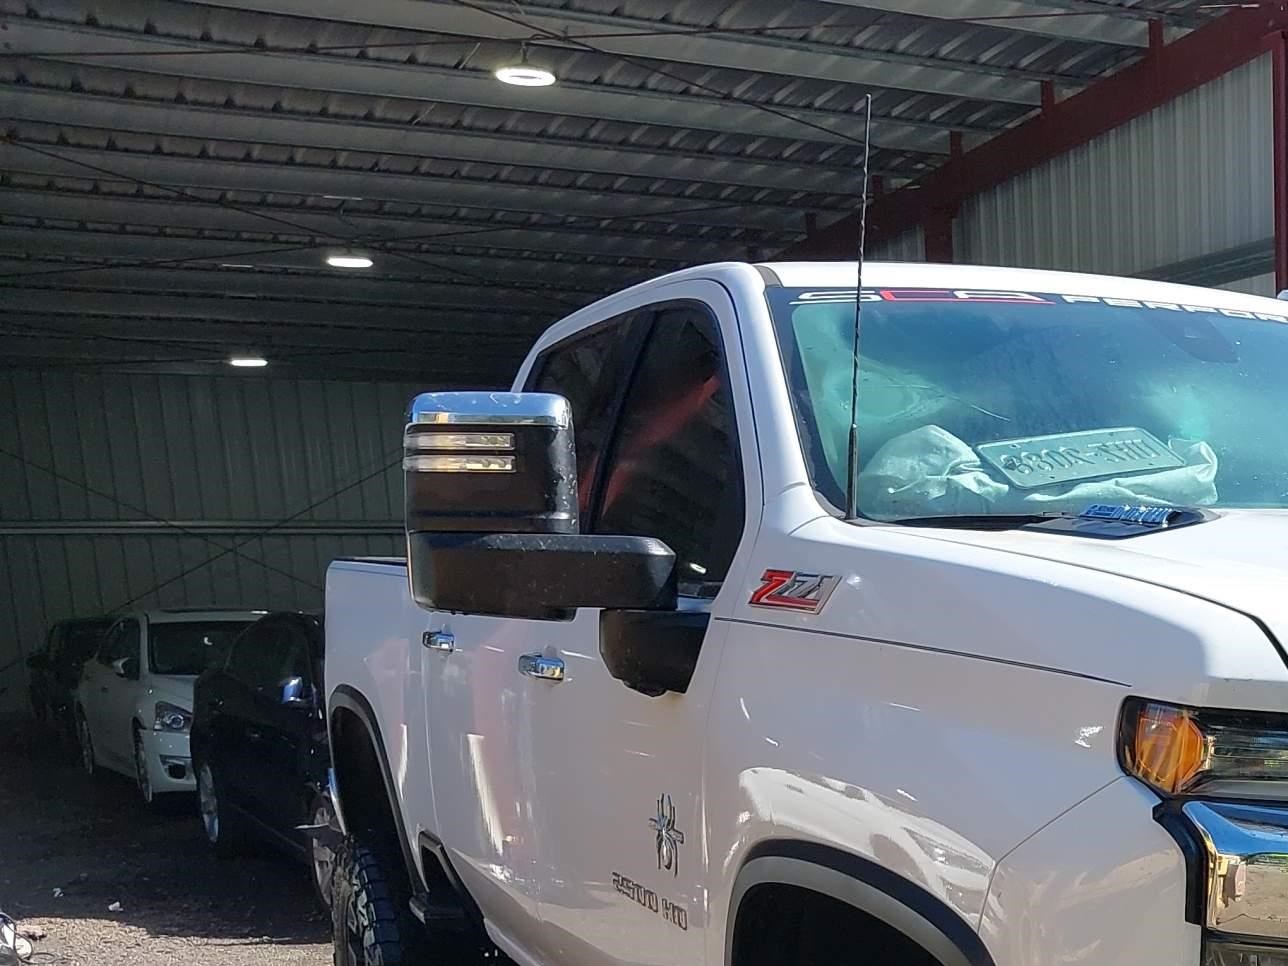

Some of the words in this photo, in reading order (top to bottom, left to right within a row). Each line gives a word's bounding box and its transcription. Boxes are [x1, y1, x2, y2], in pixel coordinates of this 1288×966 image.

[746, 568, 843, 615] Z71
[612, 871, 659, 914] 2500
[662, 898, 688, 931] HD
